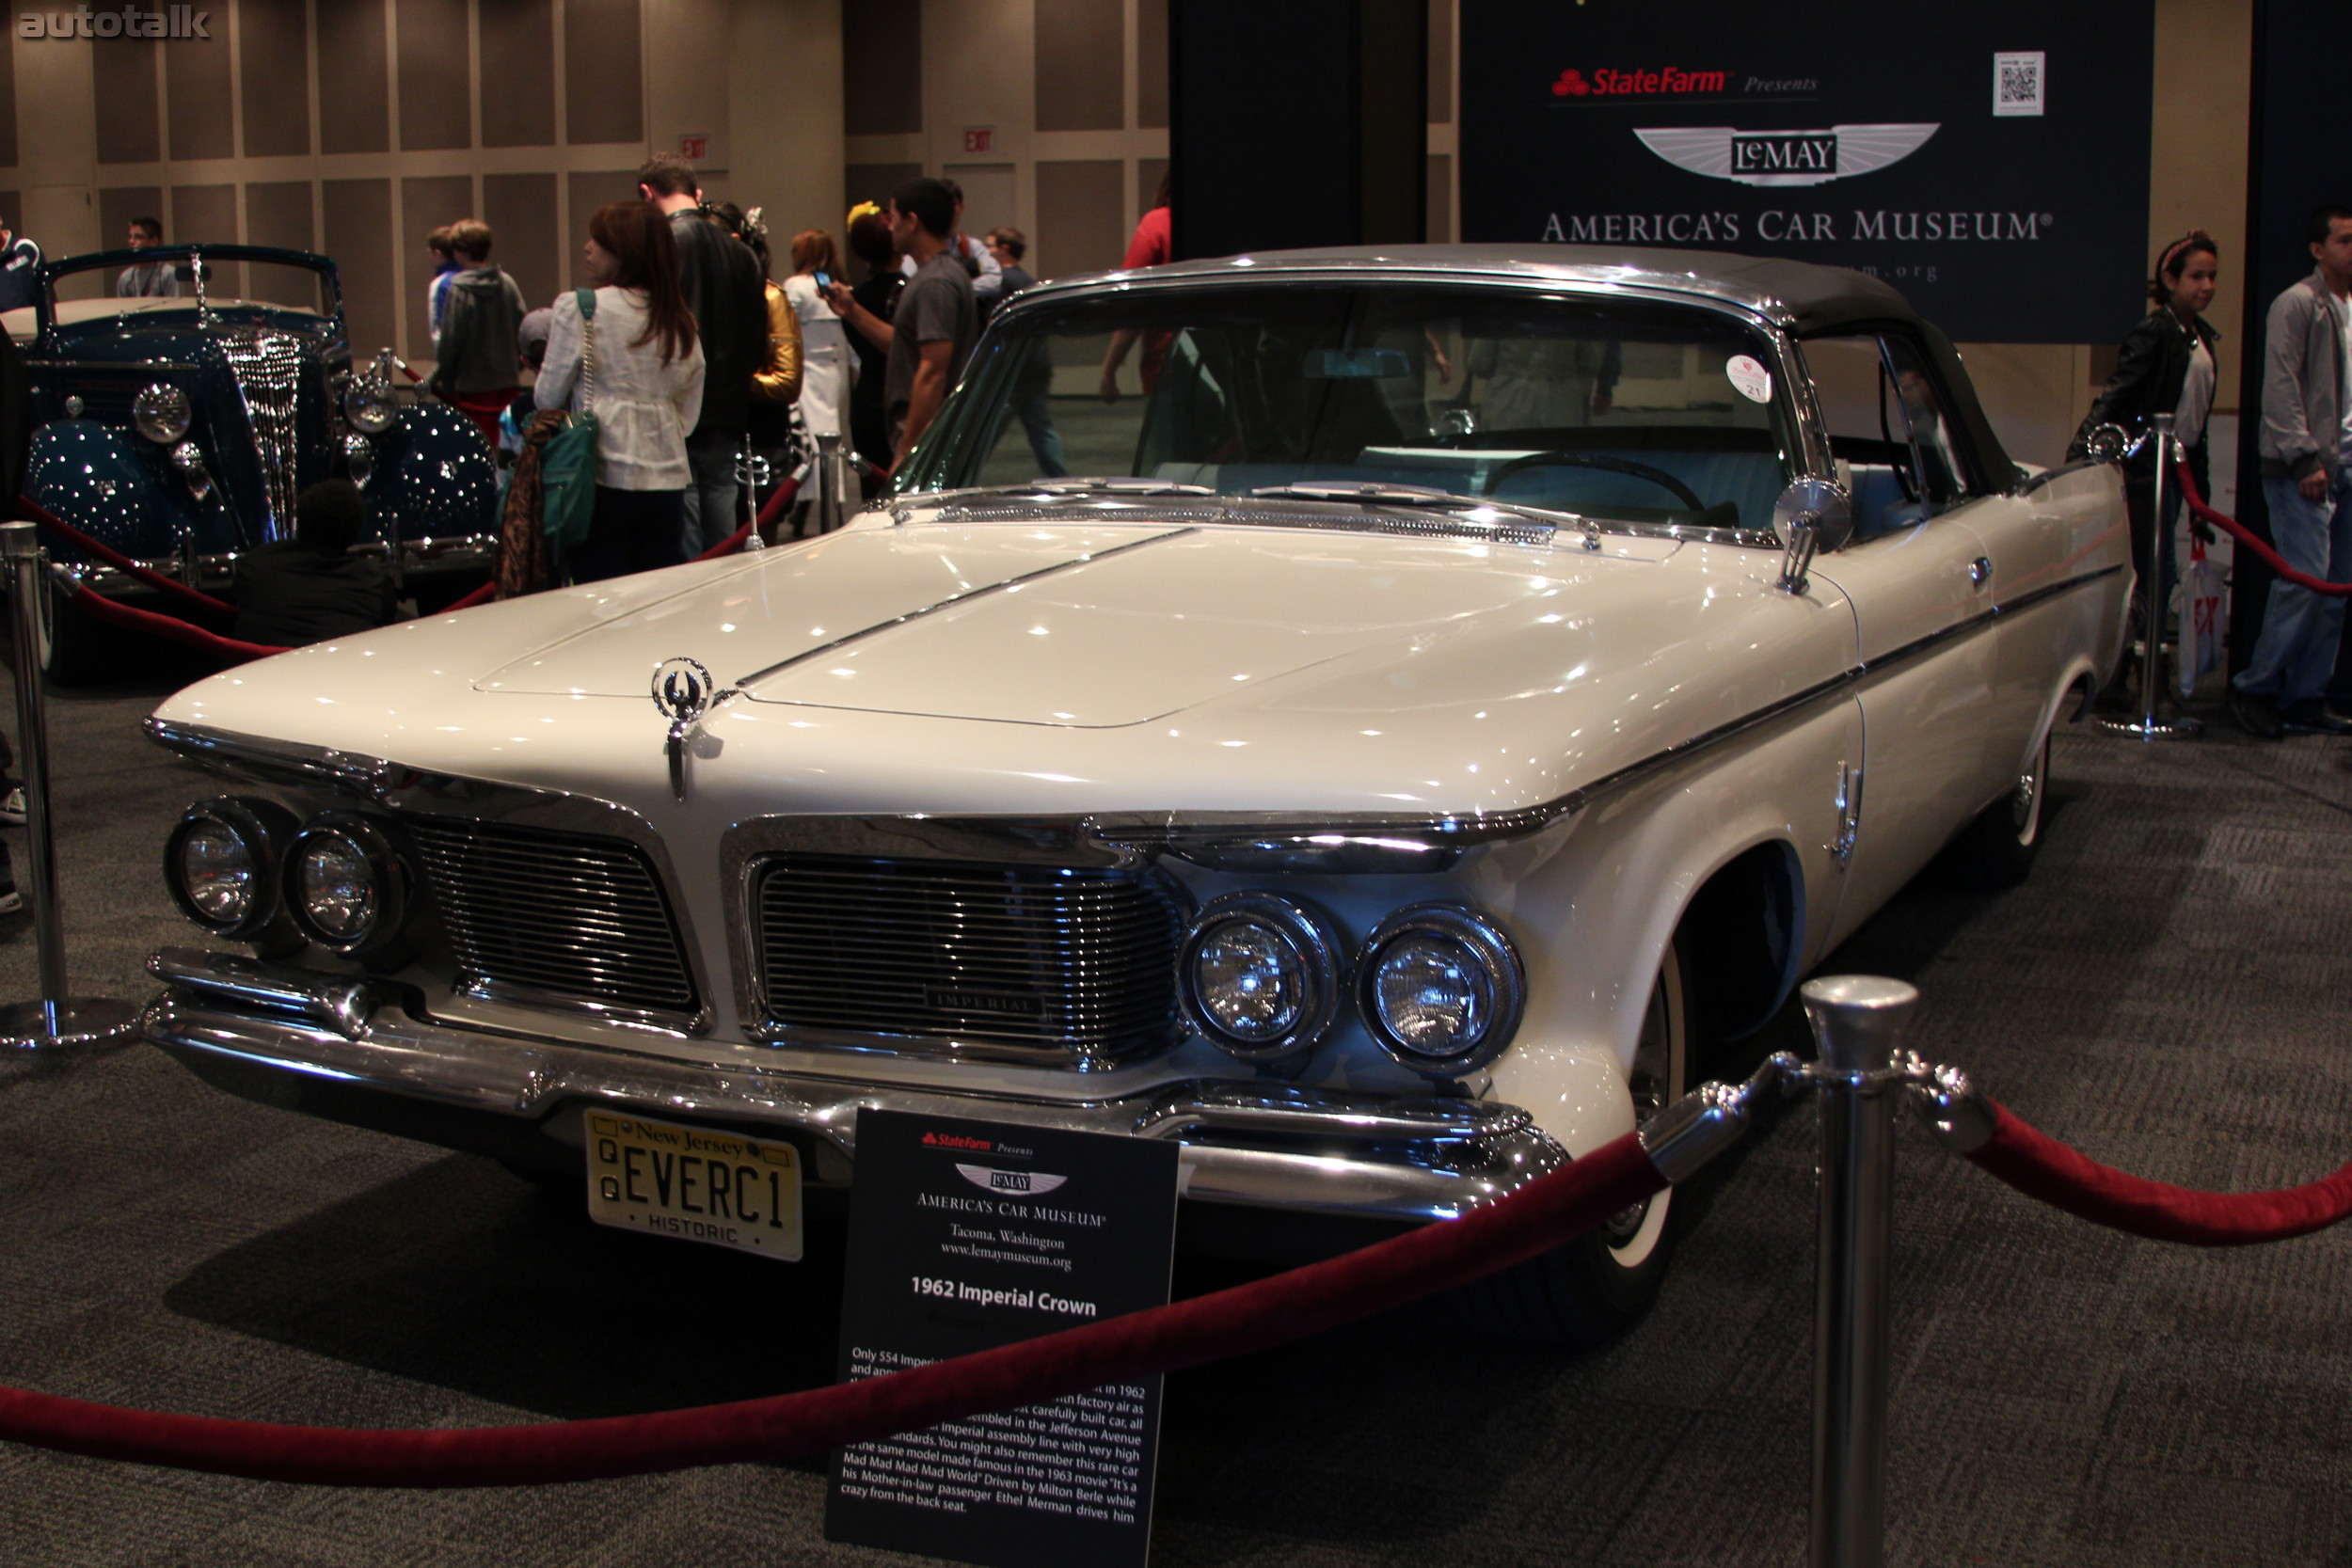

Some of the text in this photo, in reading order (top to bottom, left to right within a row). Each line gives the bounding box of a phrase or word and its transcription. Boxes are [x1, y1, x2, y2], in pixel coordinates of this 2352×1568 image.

[1743, 75, 1819, 92] Presents
[1735, 140, 1834, 170] LeMAY
[1541, 213, 1740, 242] AMERICA'S
[1757, 211, 1836, 242] CAR
[937, 994, 1033, 1011] IMPERIAL
[636, 1123, 742, 1159] New Jersey
[997, 1143, 1033, 1155] Presents
[624, 1146, 783, 1228] EVERC1
[917, 1192, 993, 1212] AMERICA'S
[998, 1202, 1028, 1218] CAR
[649, 1214, 738, 1243] HISTORIC
[999, 1229, 1065, 1251] Washington
[941, 1243, 1072, 1272] www.lemaymuseum.org
[912, 1275, 1097, 1317] 1962 Imperial Crown
[850, 1363, 872, 1375] and
[851, 1347, 877, 1363] Only
[879, 1351, 898, 1364] 554
[1076, 1394, 1115, 1413] factory
[1116, 1401, 1130, 1413] air
[1132, 1404, 1144, 1415] as
[1120, 1385, 1146, 1399] 1962
[1014, 1416, 1025, 1428] in
[1028, 1418, 1046, 1432] the
[1049, 1421, 1098, 1439] Jefferson
[1100, 1429, 1142, 1446] Avenue
[1032, 1405, 1078, 1423] carefully
[1080, 1409, 1105, 1425] built
[1129, 1418, 1143, 1430] all
[938, 1435, 958, 1449] You
[960, 1440, 992, 1455] might
[993, 1445, 1016, 1458] also
[1017, 1449, 1073, 1466] remember
[1075, 1456, 1096, 1470] this
[1098, 1463, 1120, 1474] rare
[1121, 1465, 1138, 1477] car
[941, 1422, 985, 1438] Imperial
[987, 1430, 1037, 1448] assembly
[1039, 1434, 1059, 1449] line
[1061, 1439, 1086, 1453] with
[1089, 1445, 1112, 1459] very
[1115, 1446, 1140, 1463] high
[843, 1451, 867, 1465] Mad
[869, 1455, 893, 1470] Mad
[895, 1459, 918, 1474] Mad
[921, 1464, 945, 1478] Mad
[984, 1473, 1019, 1490] Driven
[1022, 1479, 1036, 1495] by
[1038, 1481, 1073, 1498] Milton
[1075, 1487, 1104, 1503] Berle
[1106, 1494, 1136, 1508] while
[877, 1444, 905, 1457] same
[906, 1449, 940, 1462] model
[941, 1453, 972, 1467] made
[973, 1456, 1012, 1473] famous
[1013, 1463, 1025, 1475] in
[1026, 1465, 1045, 1478] the
[1048, 1467, 1073, 1482] 1963
[1074, 1474, 1108, 1488] movie
[1130, 1482, 1137, 1493] a
[840, 1483, 967, 1513] crazy from the back seat.
[842, 1465, 1135, 1523] his Mother-in-law passenger Ethel Merman drives him
